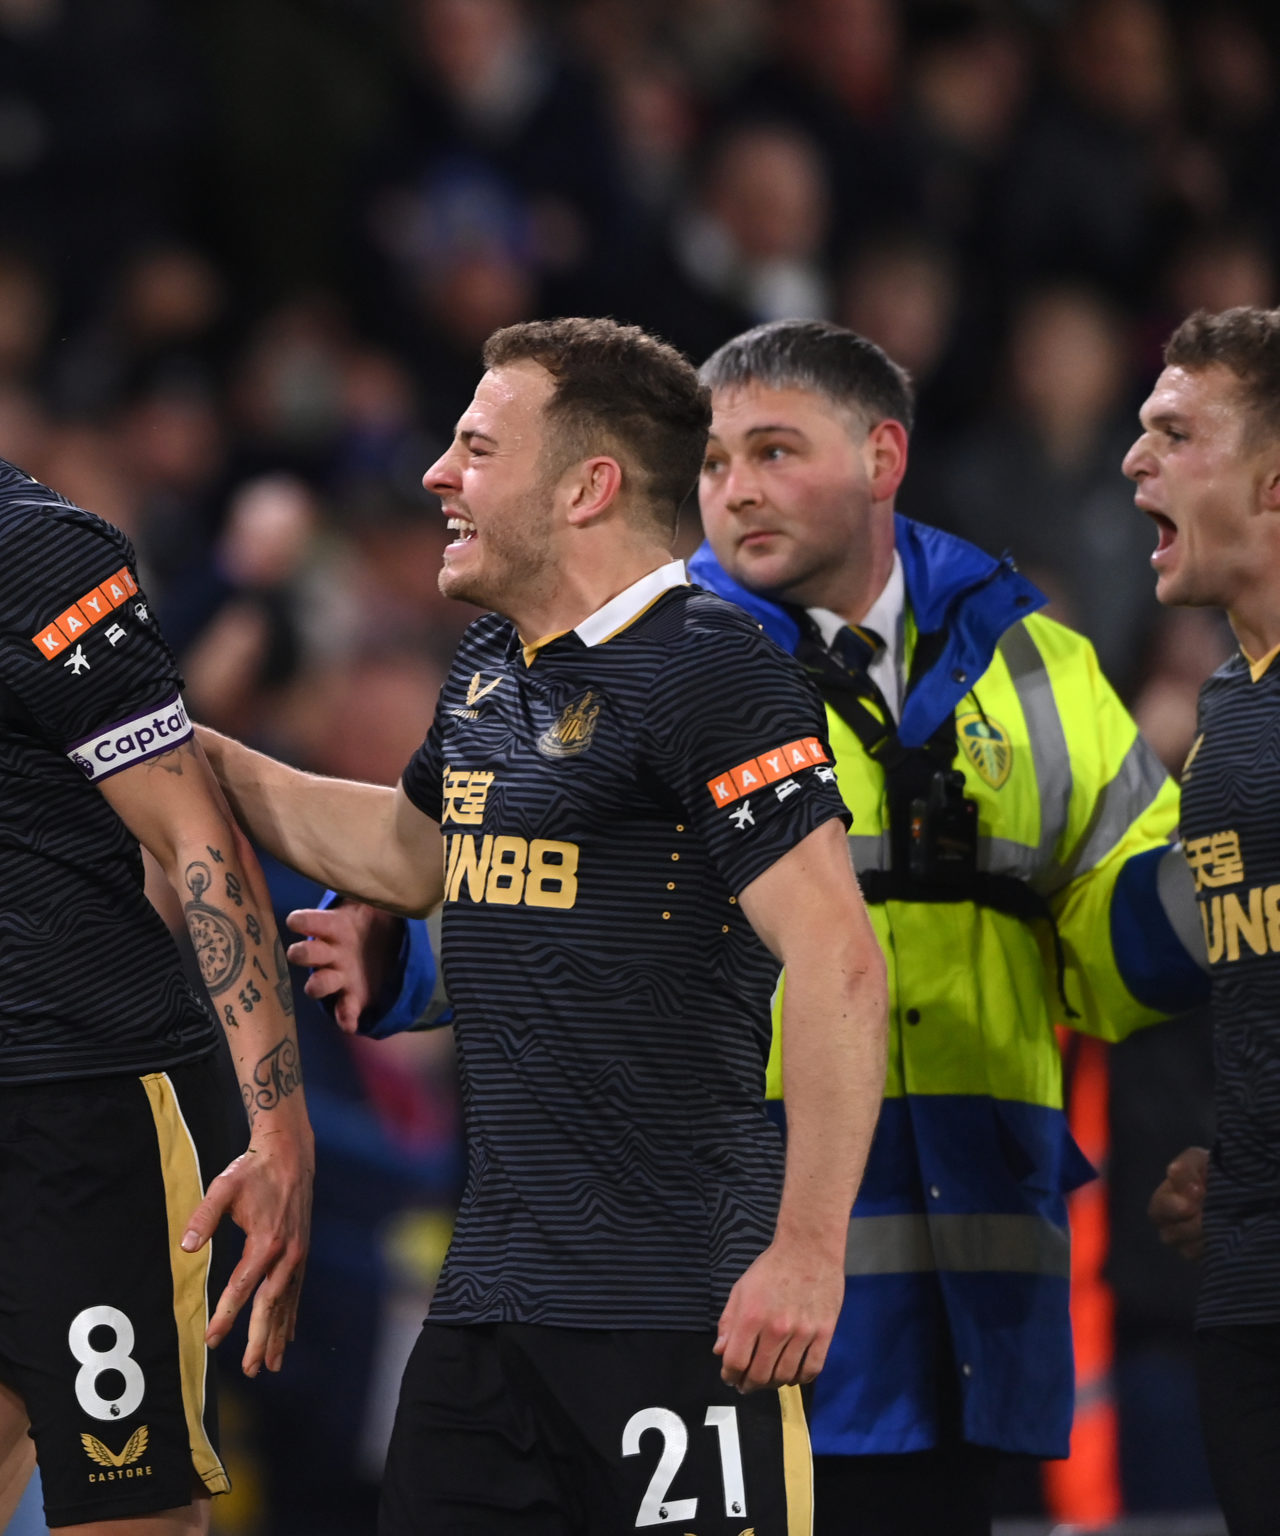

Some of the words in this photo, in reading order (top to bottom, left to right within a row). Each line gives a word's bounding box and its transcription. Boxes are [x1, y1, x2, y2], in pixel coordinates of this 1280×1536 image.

[442, 764, 496, 825] 天堂
[442, 833, 579, 909] UN88
[68, 1305, 146, 1421] 8
[88, 1465, 153, 1483] CASTORE
[621, 1405, 747, 1528] 21
